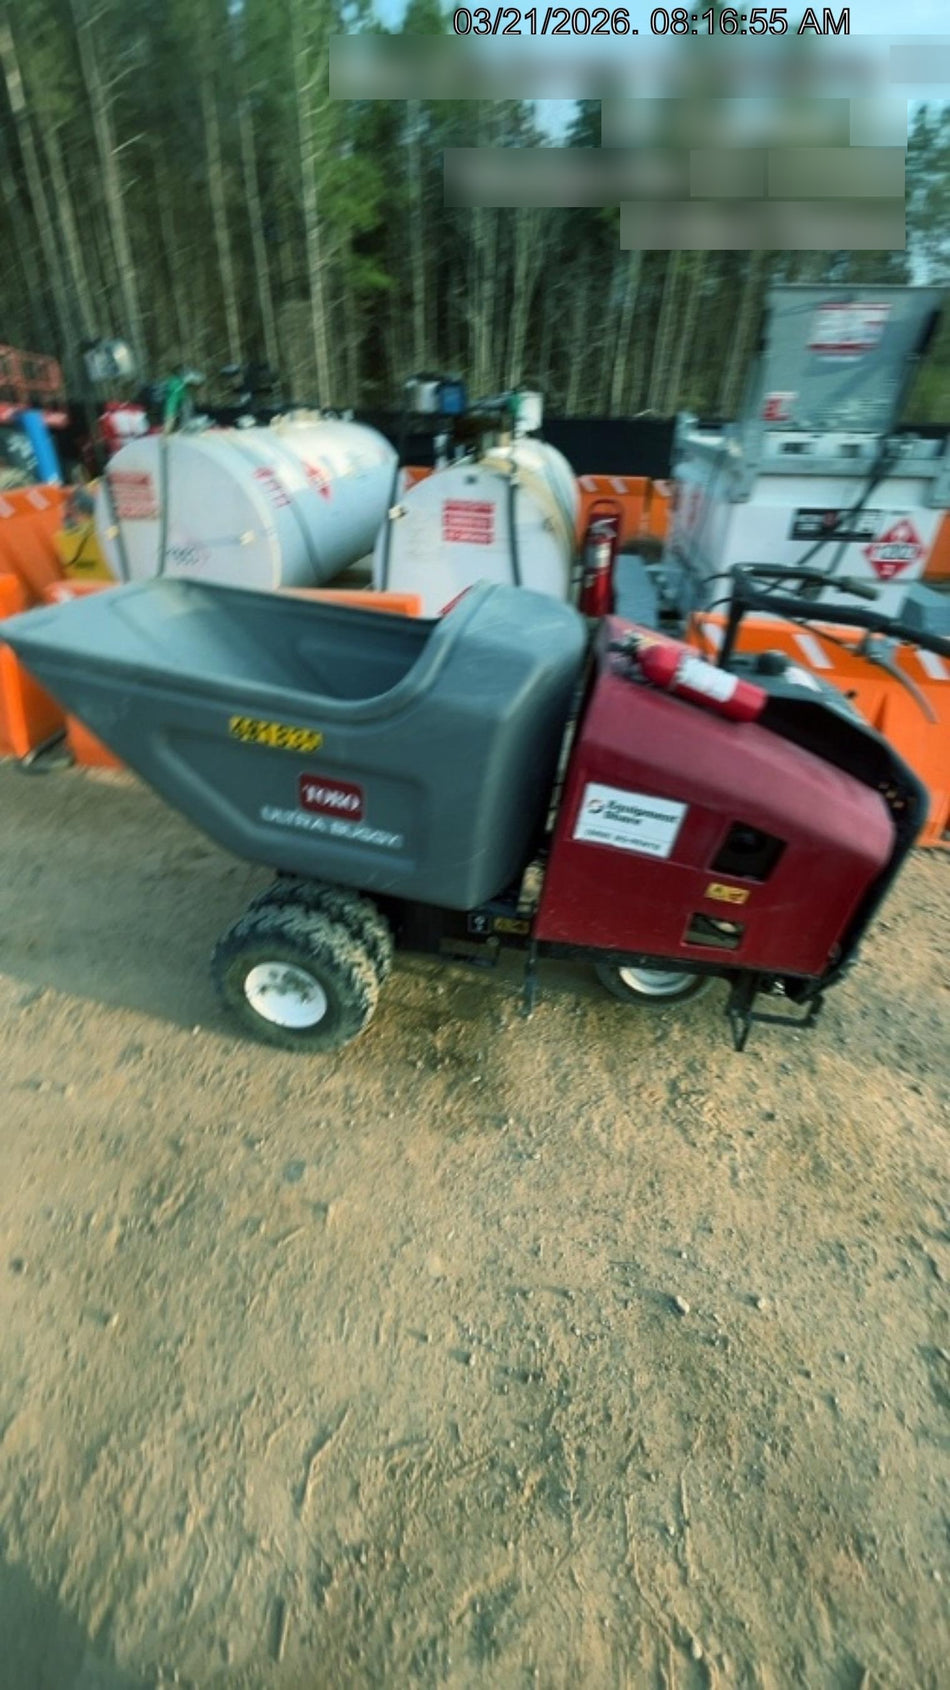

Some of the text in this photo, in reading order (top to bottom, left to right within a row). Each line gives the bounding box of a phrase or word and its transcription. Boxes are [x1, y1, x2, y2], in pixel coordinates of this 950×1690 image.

[303, 785, 360, 810] TORO
[604, 810, 641, 824] Share
[608, 800, 677, 822] Equipment
